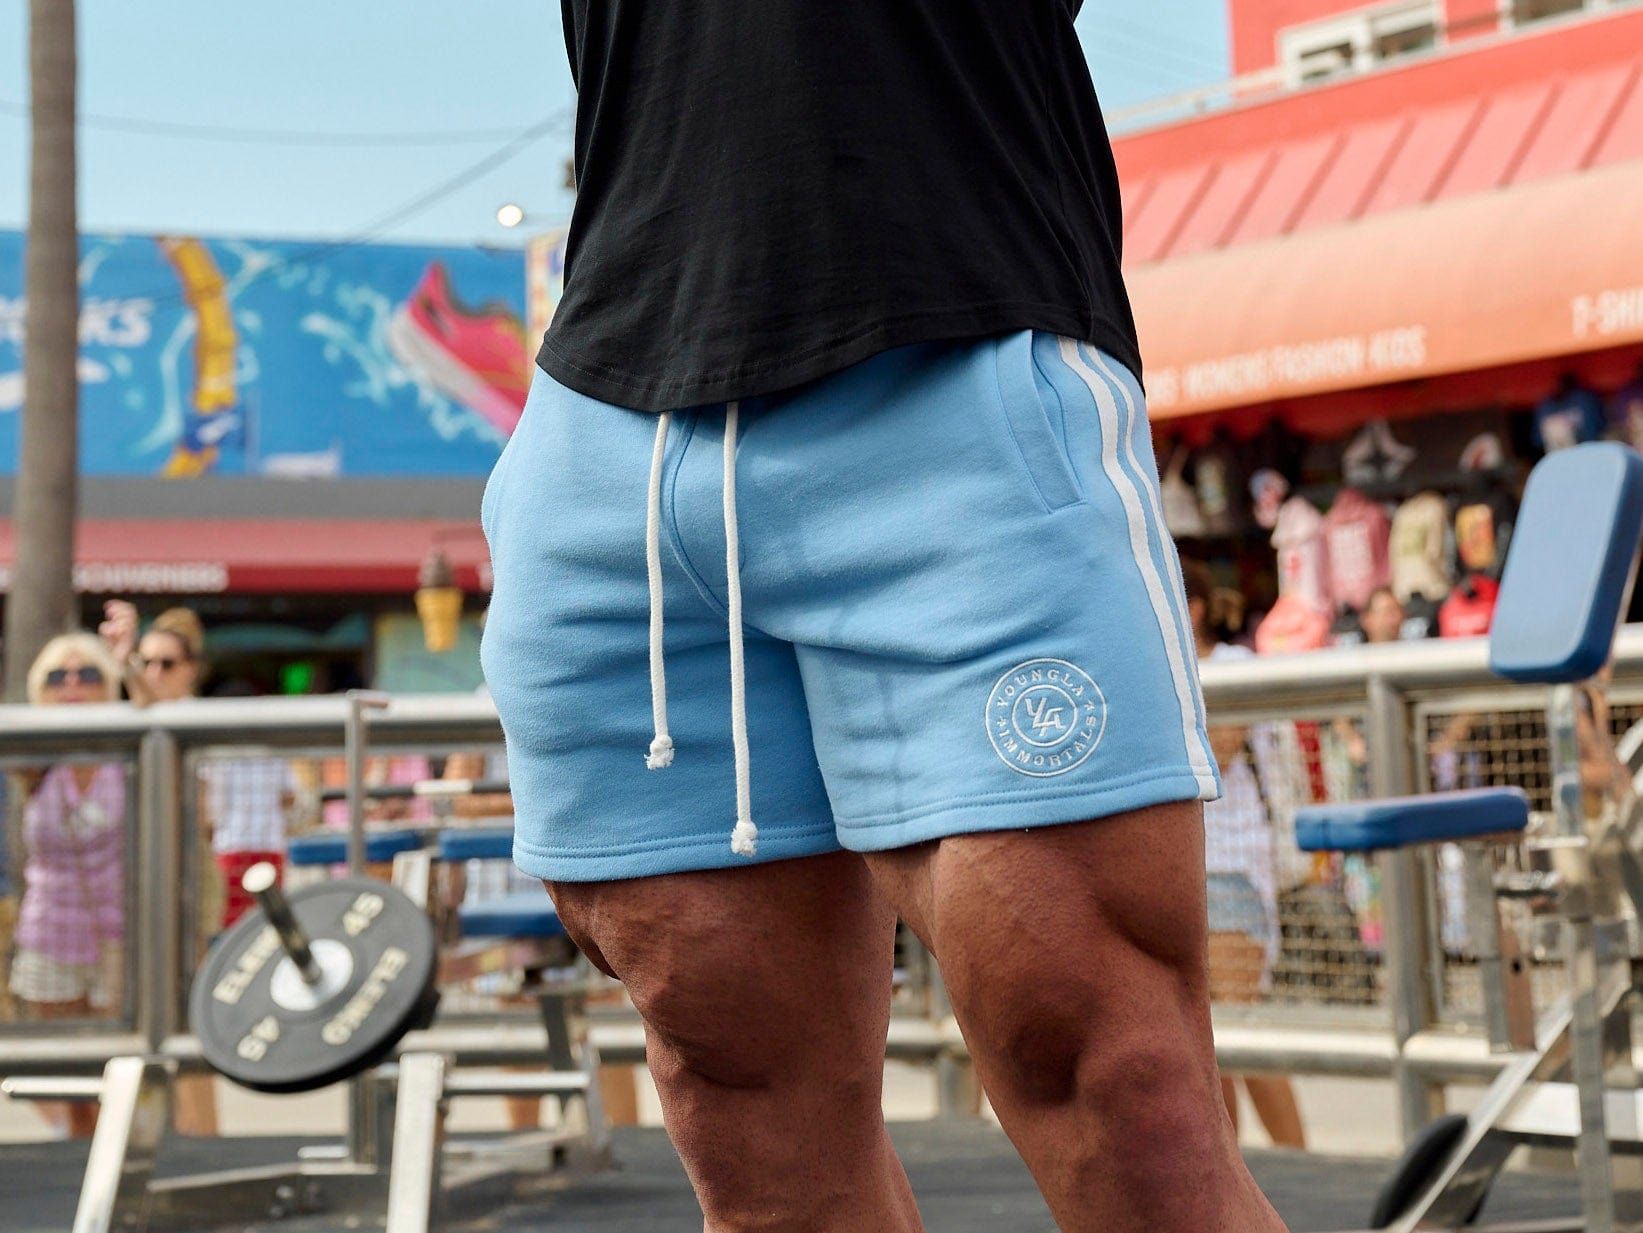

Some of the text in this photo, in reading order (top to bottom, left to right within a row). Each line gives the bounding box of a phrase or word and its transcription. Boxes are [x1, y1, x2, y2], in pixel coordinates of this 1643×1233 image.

[997, 669, 1085, 708] YOUNGLA
[999, 715, 1097, 767] IMMORTALS
[343, 891, 385, 938] 45
[237, 1015, 280, 1062] 45
